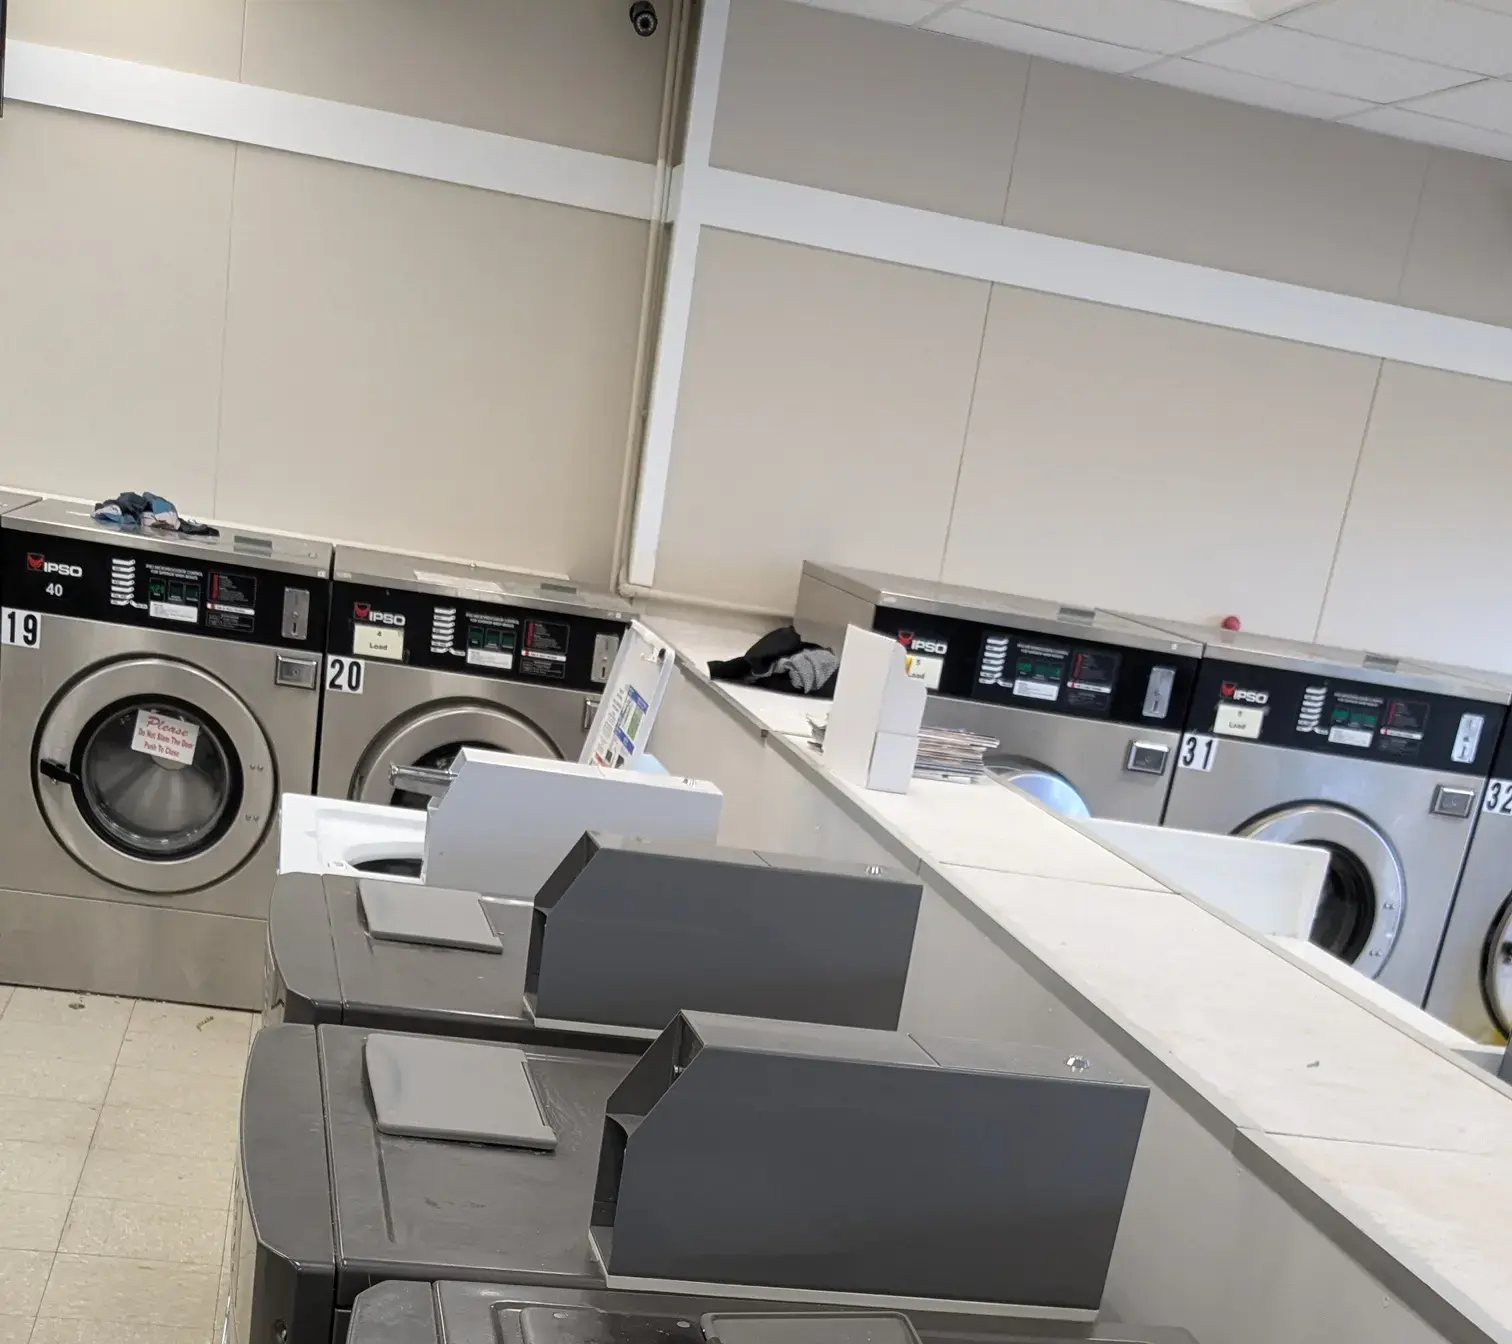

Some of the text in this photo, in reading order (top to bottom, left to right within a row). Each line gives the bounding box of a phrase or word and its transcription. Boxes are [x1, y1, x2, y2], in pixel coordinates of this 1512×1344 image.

[44, 561, 82, 577] IPSO
[46, 582, 63, 596] 40
[369, 611, 406, 626] IPSO
[8, 611, 38, 646] 19
[911, 639, 948, 655] IPSO
[329, 659, 362, 692] 20
[1233, 689, 1268, 704] IPSO
[146, 715, 189, 737] Please
[138, 728, 146, 737] Do
[146, 729, 156, 740] Not
[171, 736, 181, 746] The
[181, 740, 194, 749] Door
[144, 741, 180, 757] Push To Close
[1183, 736, 1213, 769] 31
[1487, 782, 1512, 813] 32
